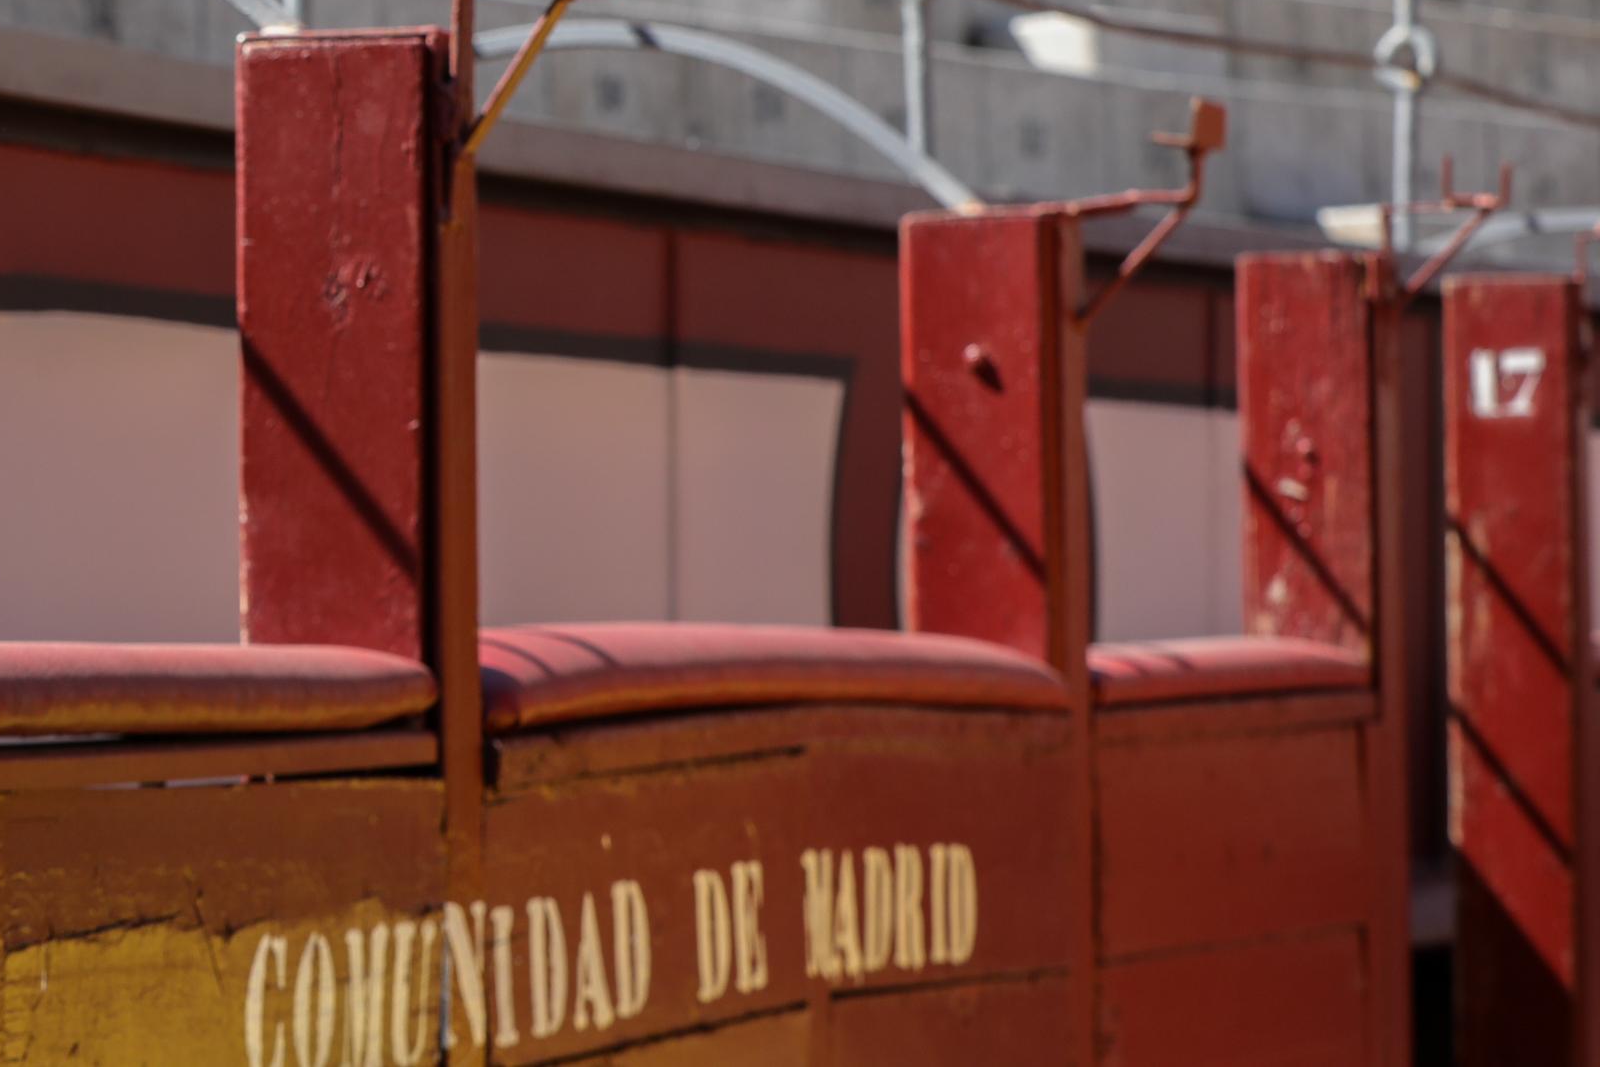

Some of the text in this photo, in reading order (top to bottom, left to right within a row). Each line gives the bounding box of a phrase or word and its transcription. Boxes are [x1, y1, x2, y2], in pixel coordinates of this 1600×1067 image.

[1469, 347, 1547, 419] 17
[244, 843, 979, 1067] COMUNIDAD DE MADRID
